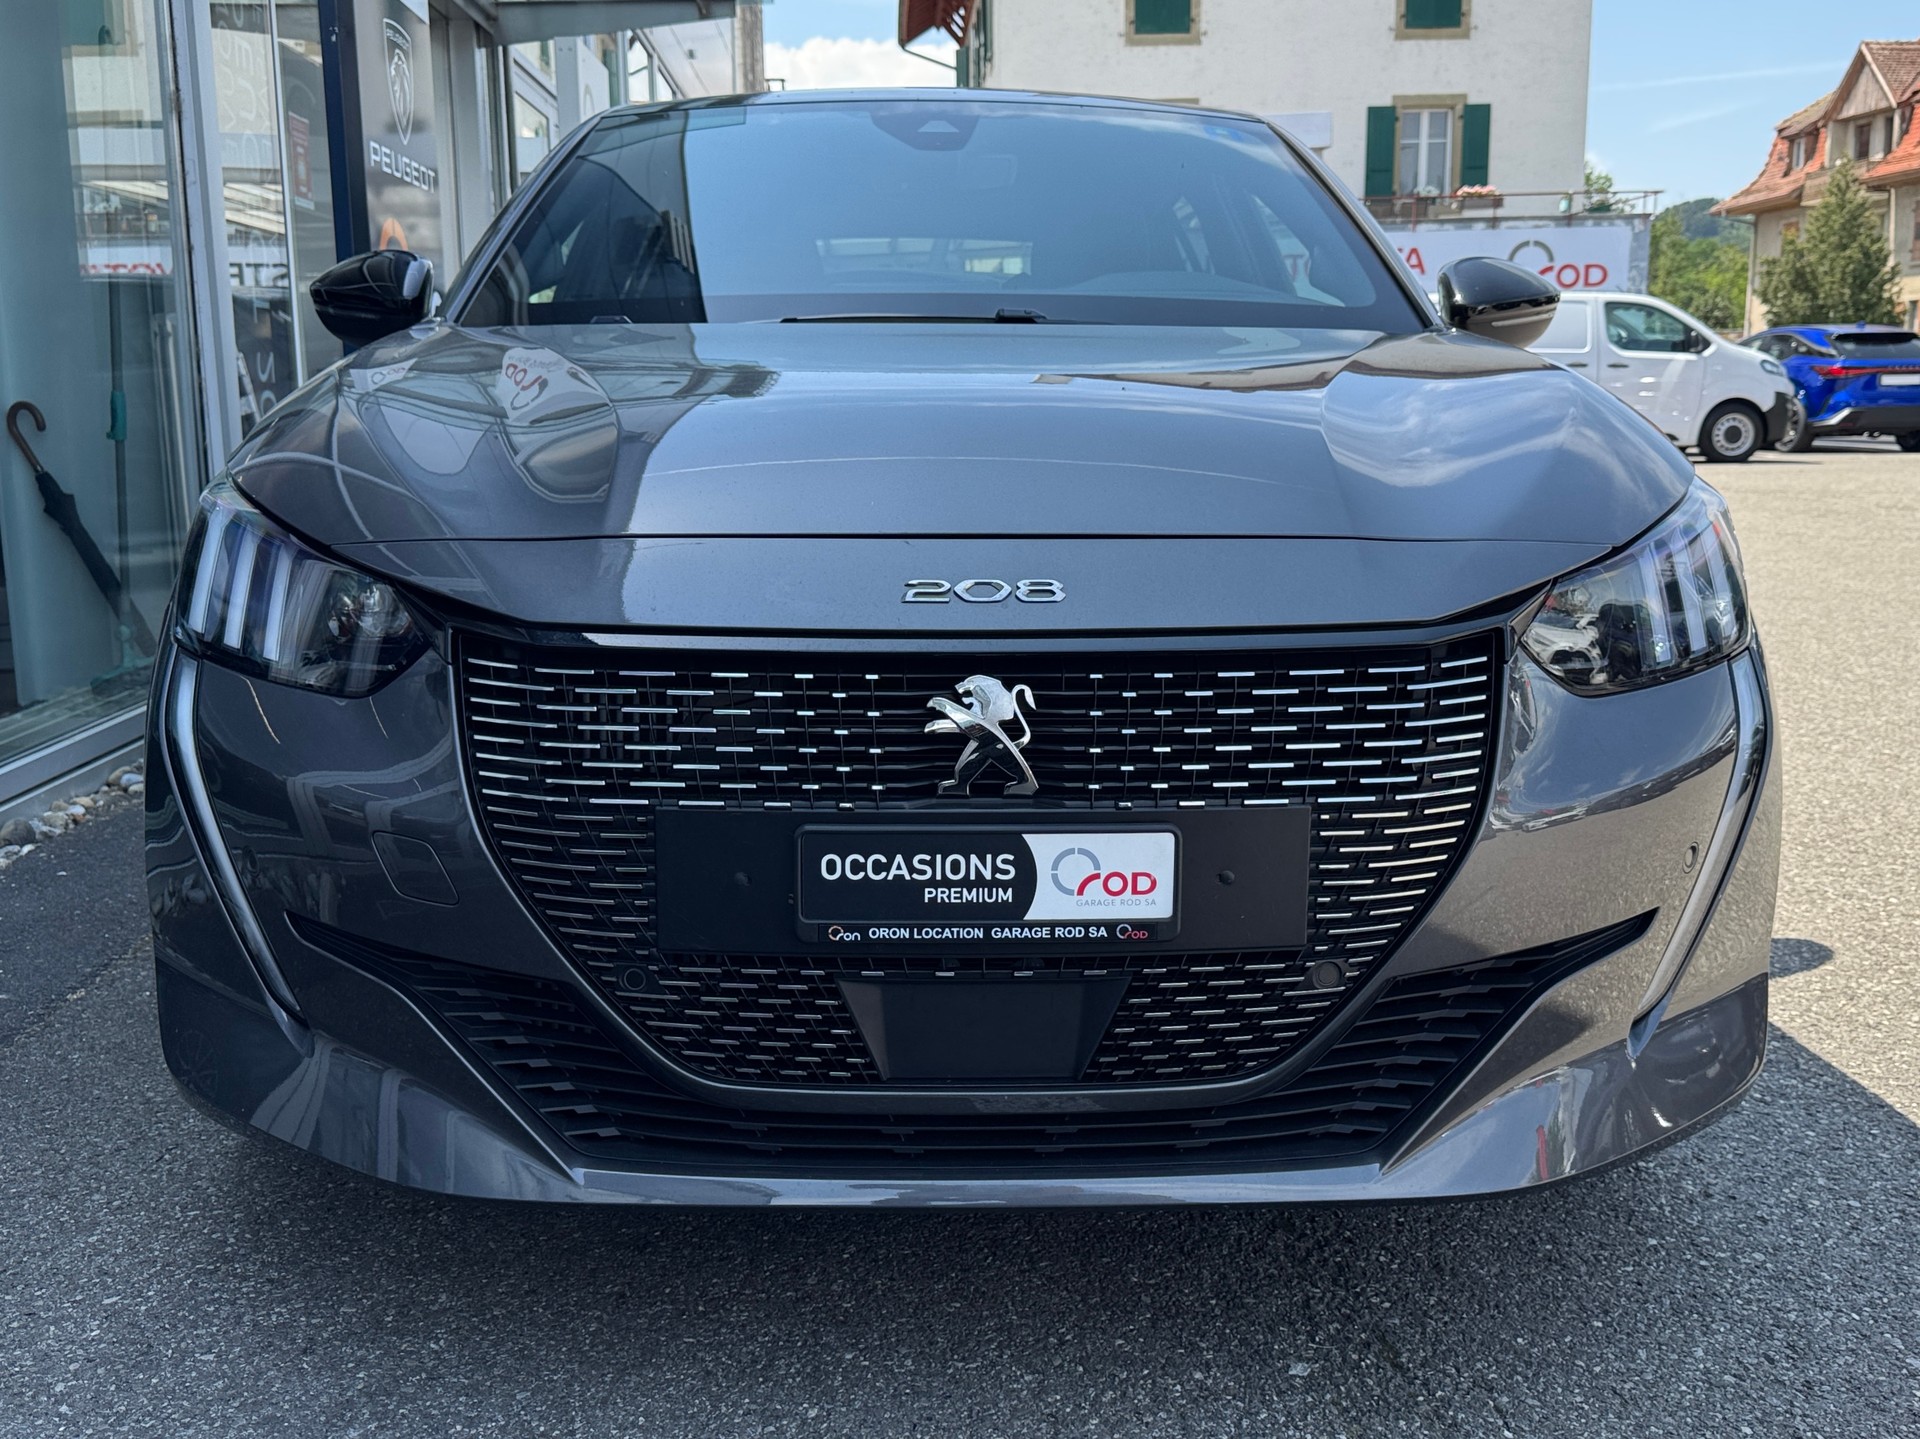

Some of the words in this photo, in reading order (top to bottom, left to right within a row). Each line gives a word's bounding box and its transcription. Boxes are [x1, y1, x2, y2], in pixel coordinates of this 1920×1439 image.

[369, 140, 435, 193] PEUGEOT
[901, 579, 1067, 604] 208
[820, 853, 1016, 881] OCCASIONS
[924, 887, 1013, 903] PREMIUM
[1076, 899, 1116, 907] GARAGE
[1145, 898, 1157, 906] SA
[868, 927, 910, 939] ORON
[913, 927, 984, 939] LOCATION
[991, 927, 1051, 939] GARAGE
[1055, 927, 1085, 939] ROD
[1088, 926, 1108, 938] SA
